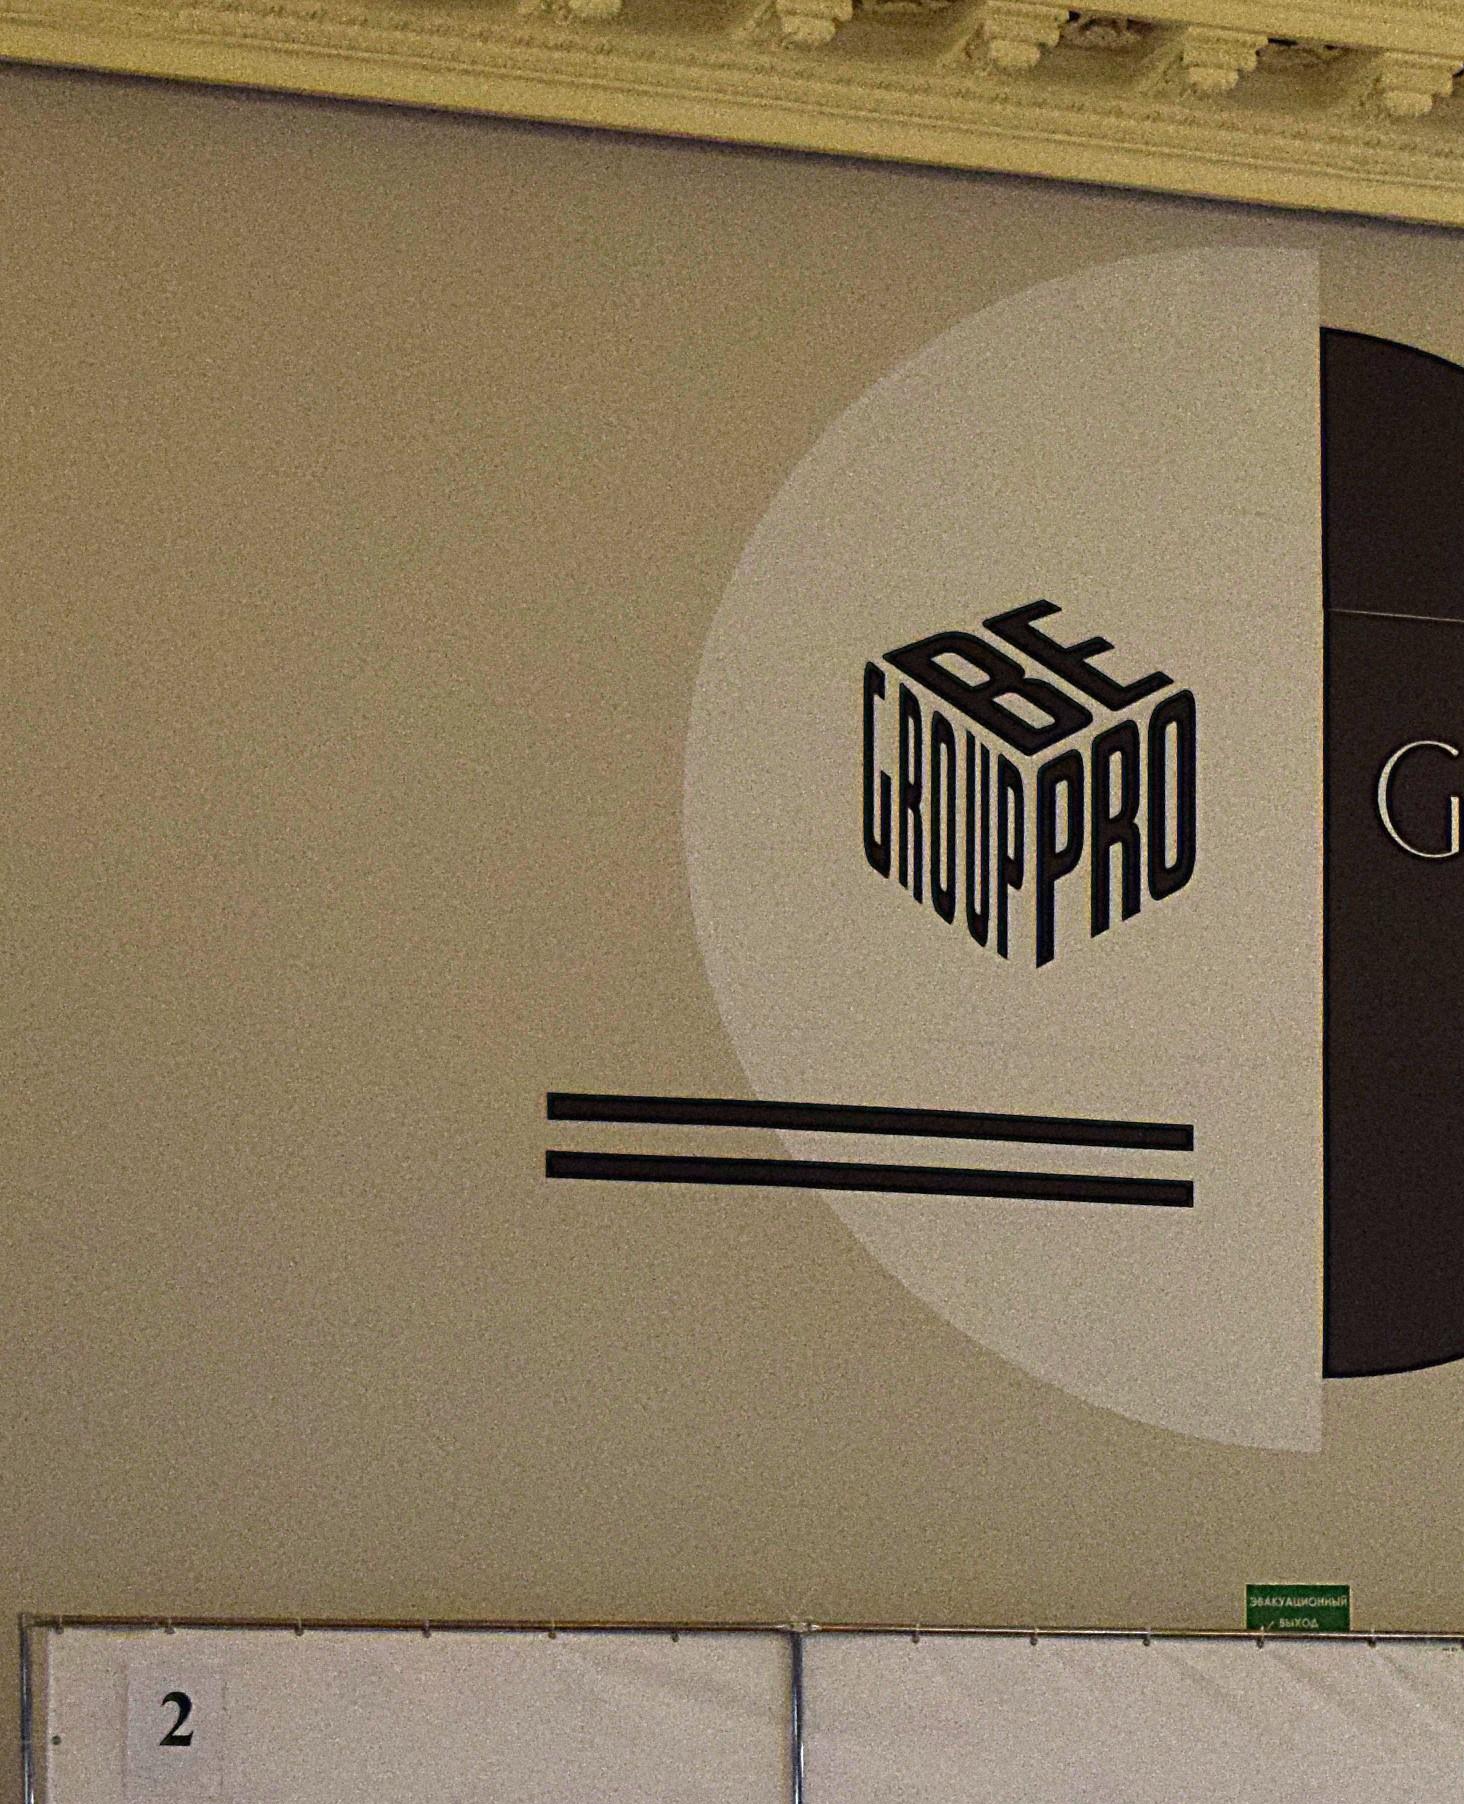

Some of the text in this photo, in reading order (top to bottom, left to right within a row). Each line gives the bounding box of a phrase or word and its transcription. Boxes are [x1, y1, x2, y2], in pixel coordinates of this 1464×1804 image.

[882, 599, 1173, 757] BE
[863, 660, 1025, 960] GROUP
[1035, 688, 1196, 968] PRO
[1249, 1595, 1348, 1607] ЭВАКУАЦИОННЫЙ
[1279, 1617, 1319, 1628] ВЫХОД
[159, 1691, 194, 1746] 2
